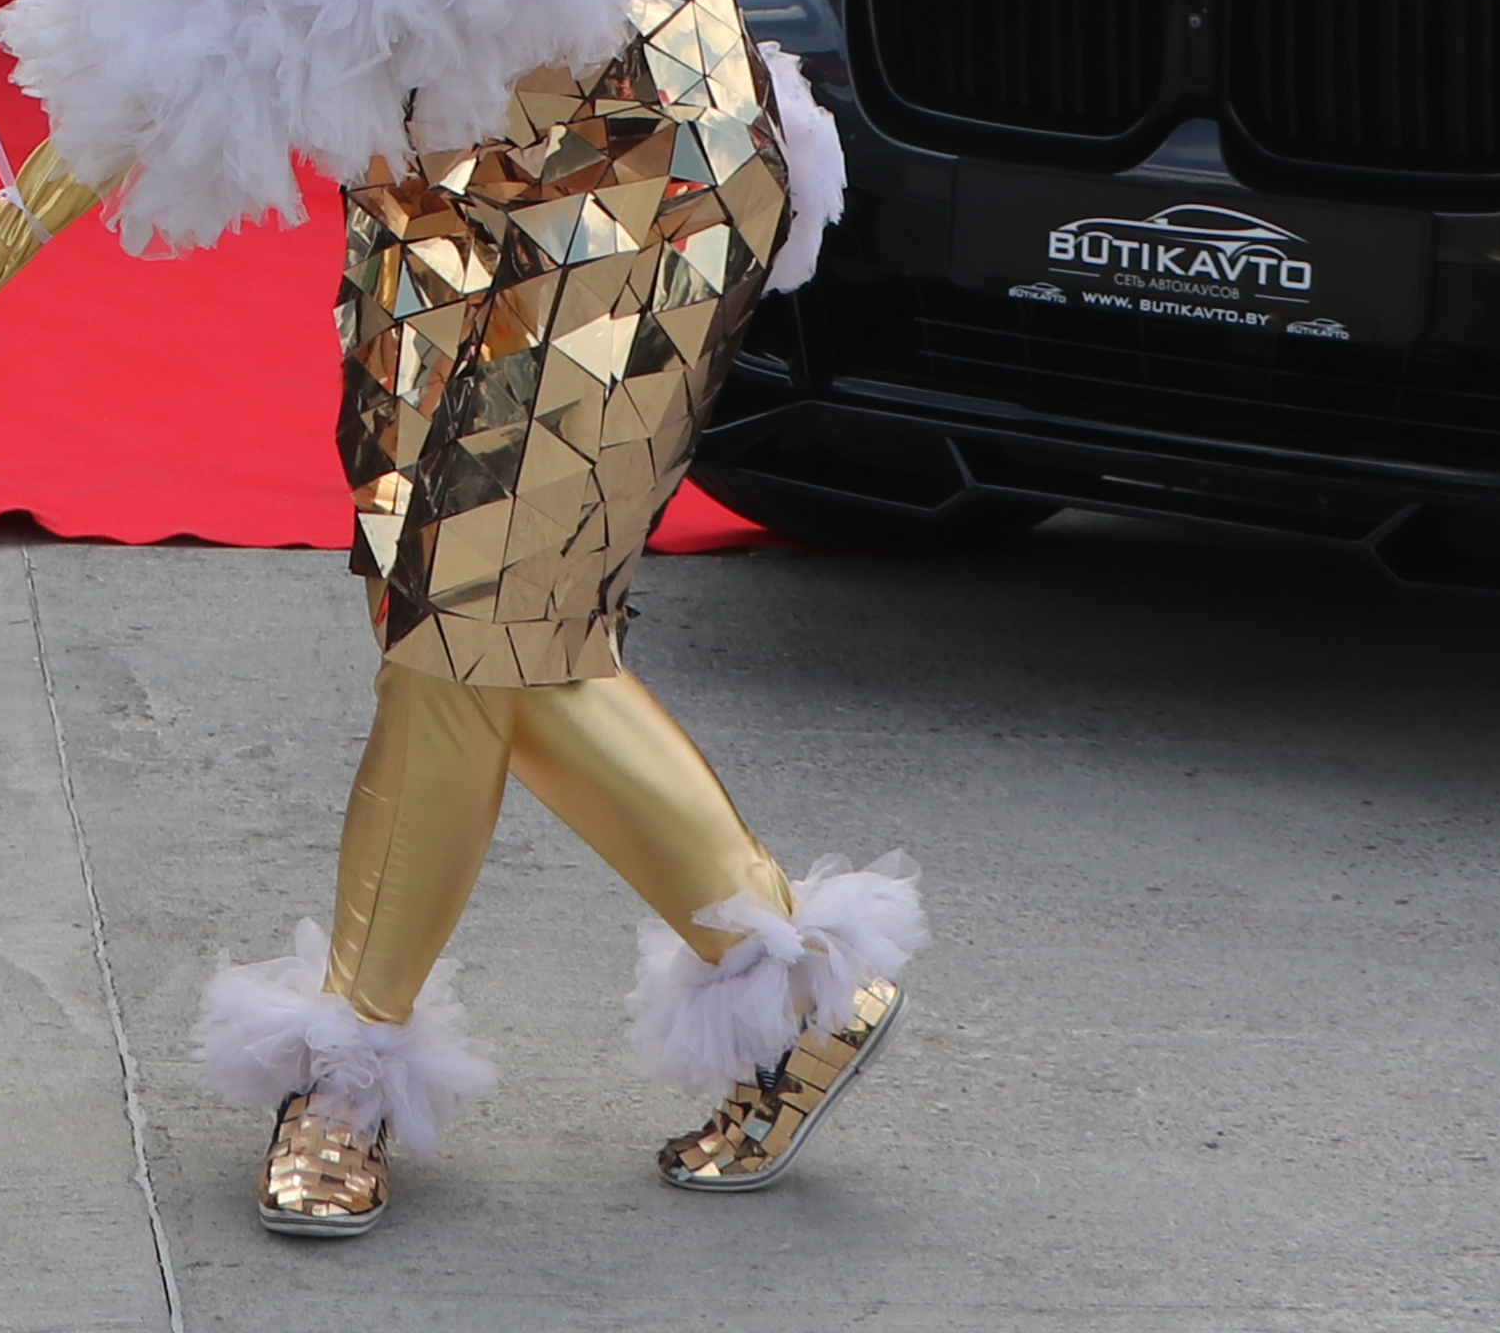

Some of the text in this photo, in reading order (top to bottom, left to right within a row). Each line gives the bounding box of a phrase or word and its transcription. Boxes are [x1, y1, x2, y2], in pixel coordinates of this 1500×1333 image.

[1048, 230, 1312, 290] BUTIKAVTO
[1113, 272, 1240, 300] СЕТЬ АВТОХАУСОВ
[1139, 298, 1271, 326] BUTIKAVTO.BY
